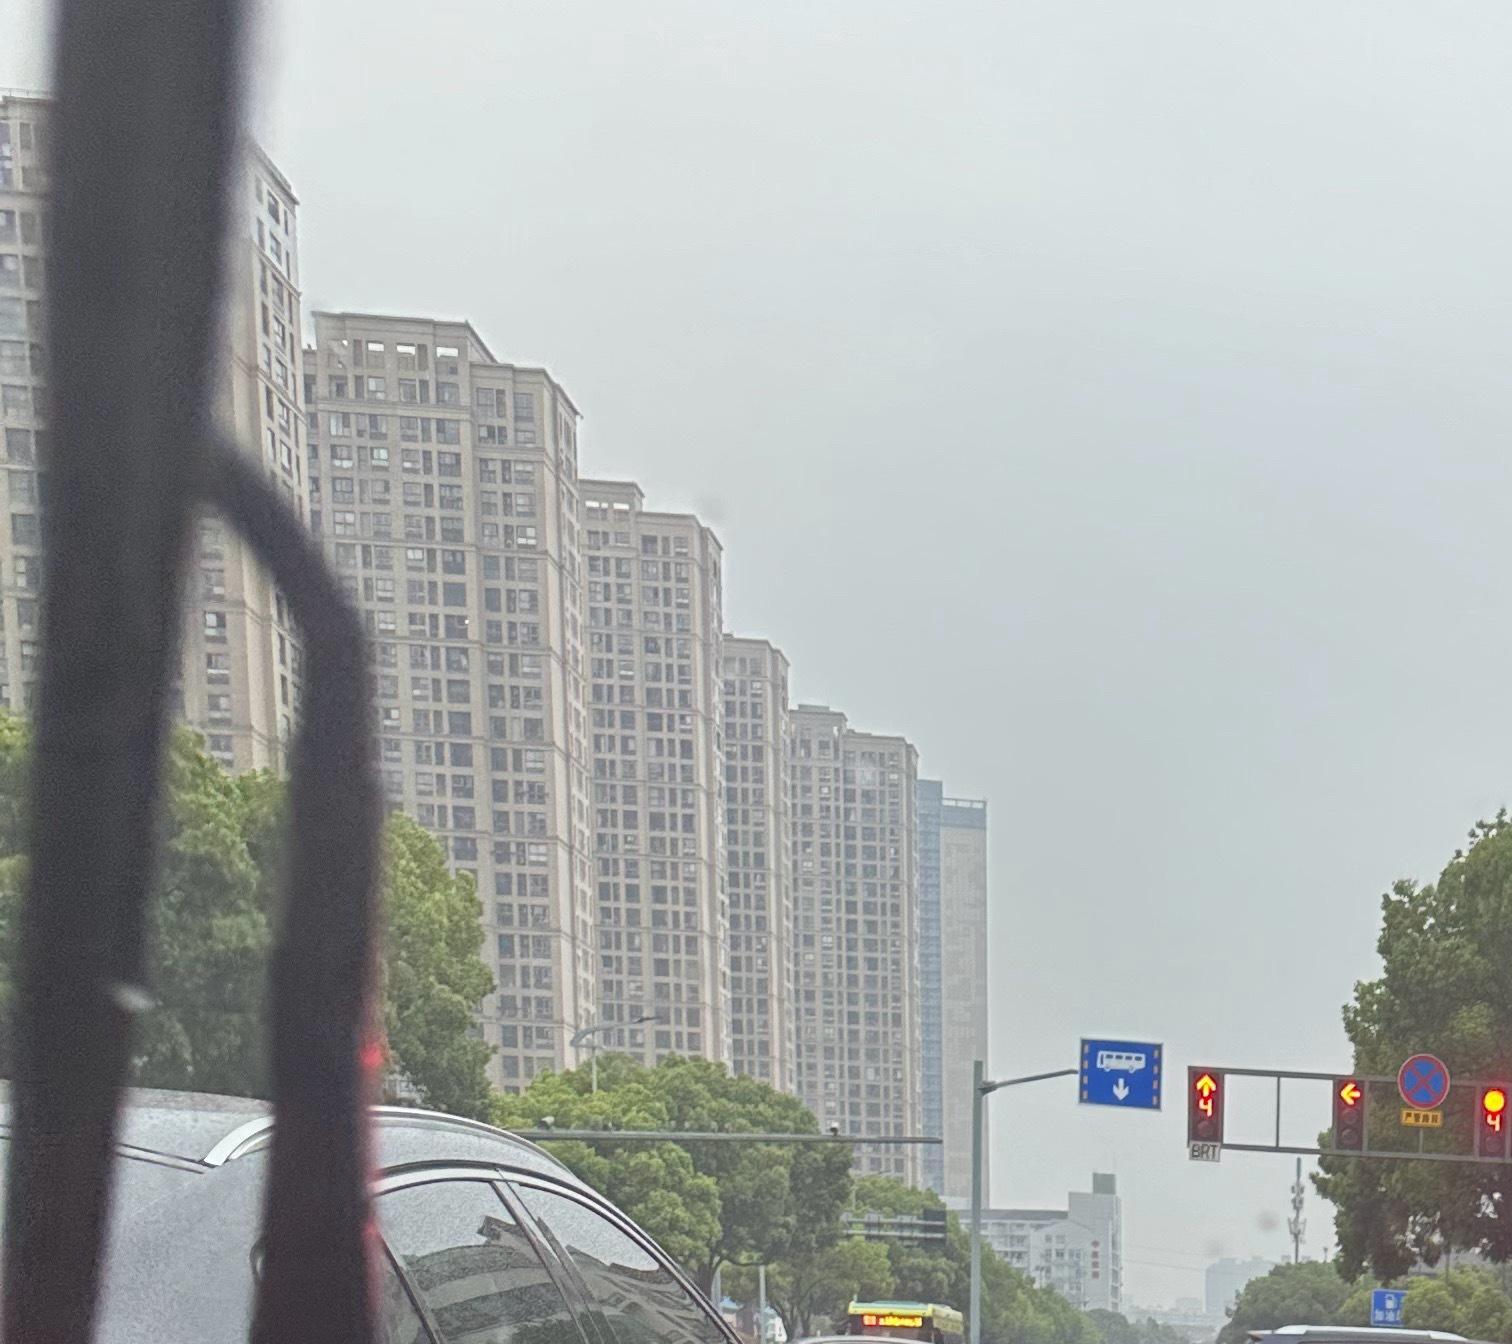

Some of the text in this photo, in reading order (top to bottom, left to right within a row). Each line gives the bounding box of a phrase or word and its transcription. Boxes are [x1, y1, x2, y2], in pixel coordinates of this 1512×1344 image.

[1199, 1098, 1213, 1117] 4
[1486, 1113, 1500, 1132] 4
[1191, 1143, 1218, 1160] BRT
